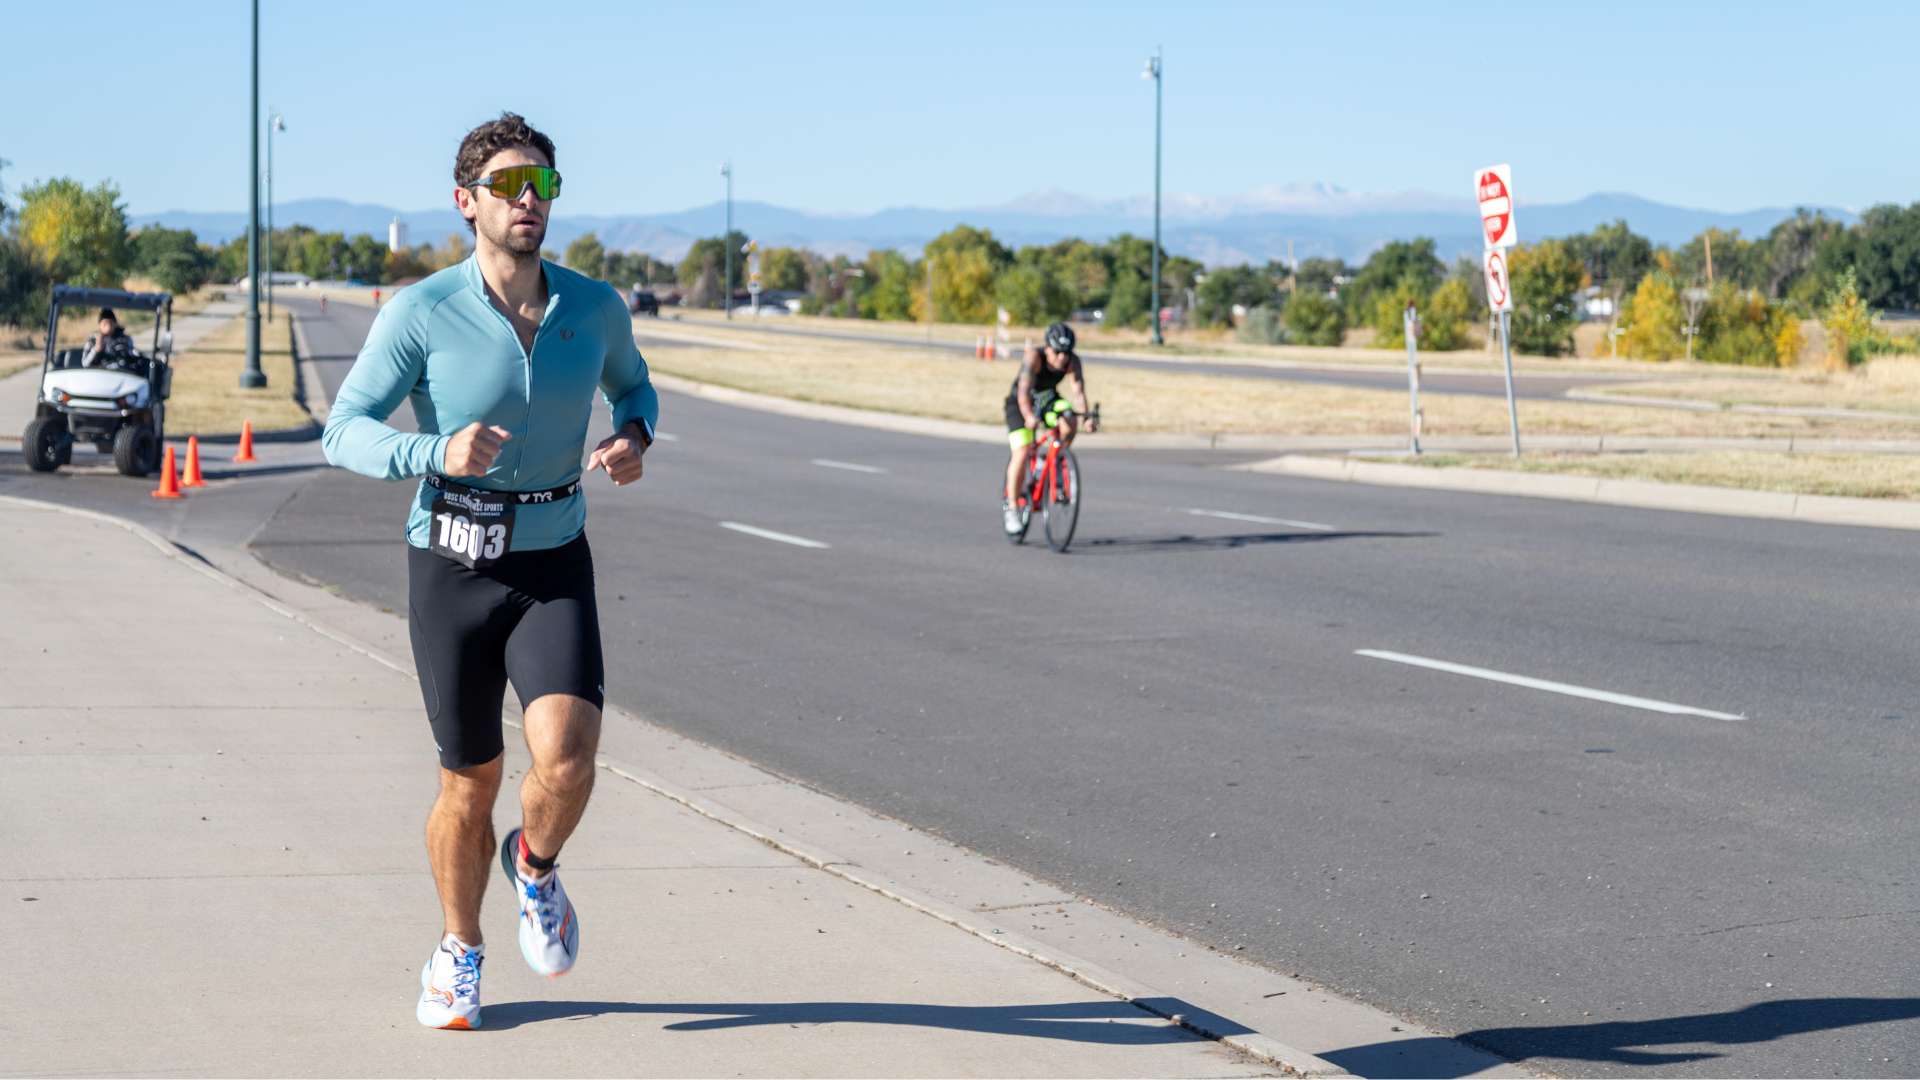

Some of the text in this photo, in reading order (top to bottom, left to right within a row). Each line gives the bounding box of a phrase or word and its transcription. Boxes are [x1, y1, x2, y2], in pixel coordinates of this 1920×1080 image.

[533, 491, 553, 503] TYR
[484, 503, 504, 512] SPORTS
[436, 512, 507, 561] 1603
